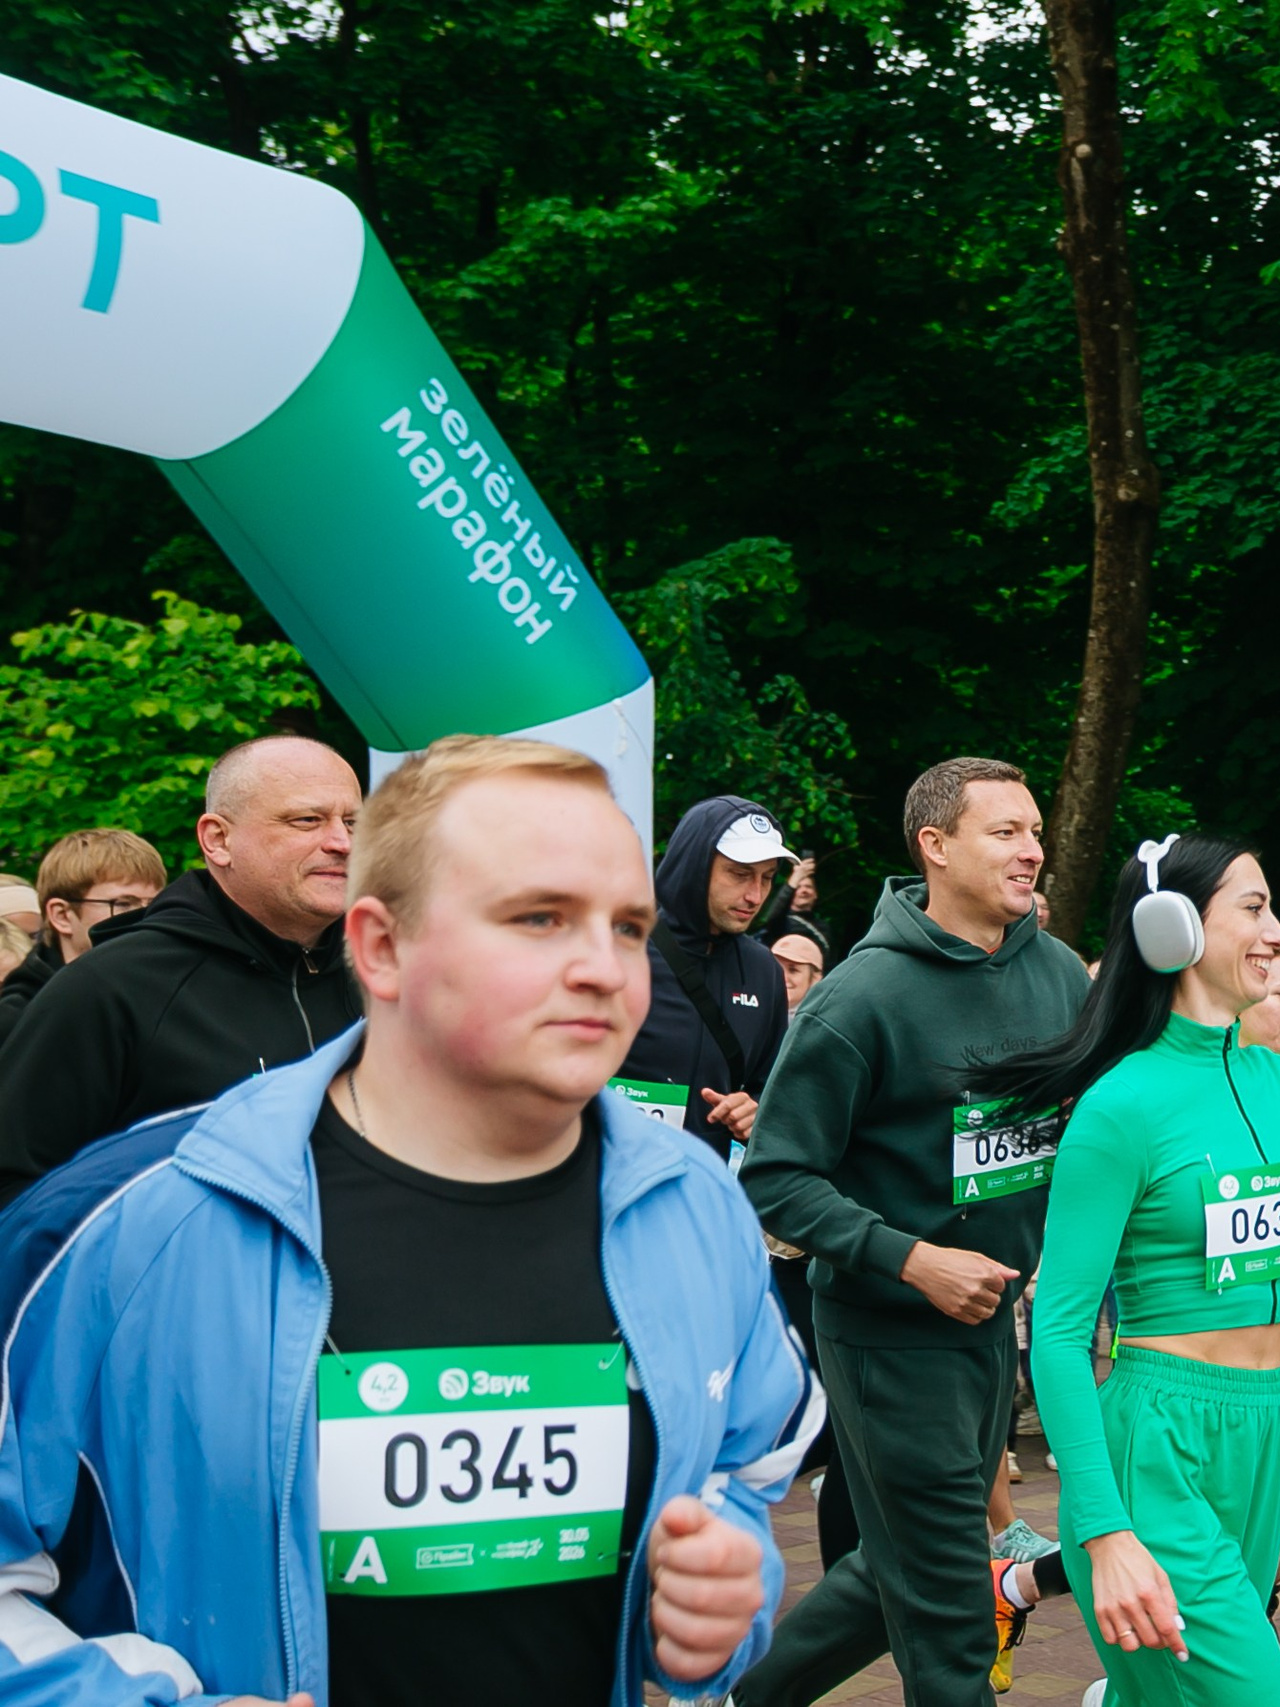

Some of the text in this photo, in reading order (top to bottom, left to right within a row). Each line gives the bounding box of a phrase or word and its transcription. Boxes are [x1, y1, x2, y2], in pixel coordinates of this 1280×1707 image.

[419, 378, 578, 611] зелёный
[381, 406, 552, 644] марафон
[733, 993, 759, 1007] FILA
[963, 1036, 1038, 1059] New days
[627, 1087, 649, 1098] Звук
[1218, 1257, 1236, 1282] A
[371, 1374, 398, 1395] 4,2
[472, 1371, 530, 1398] Звук
[384, 1424, 578, 1508] 0345
[344, 1536, 388, 1584] A
